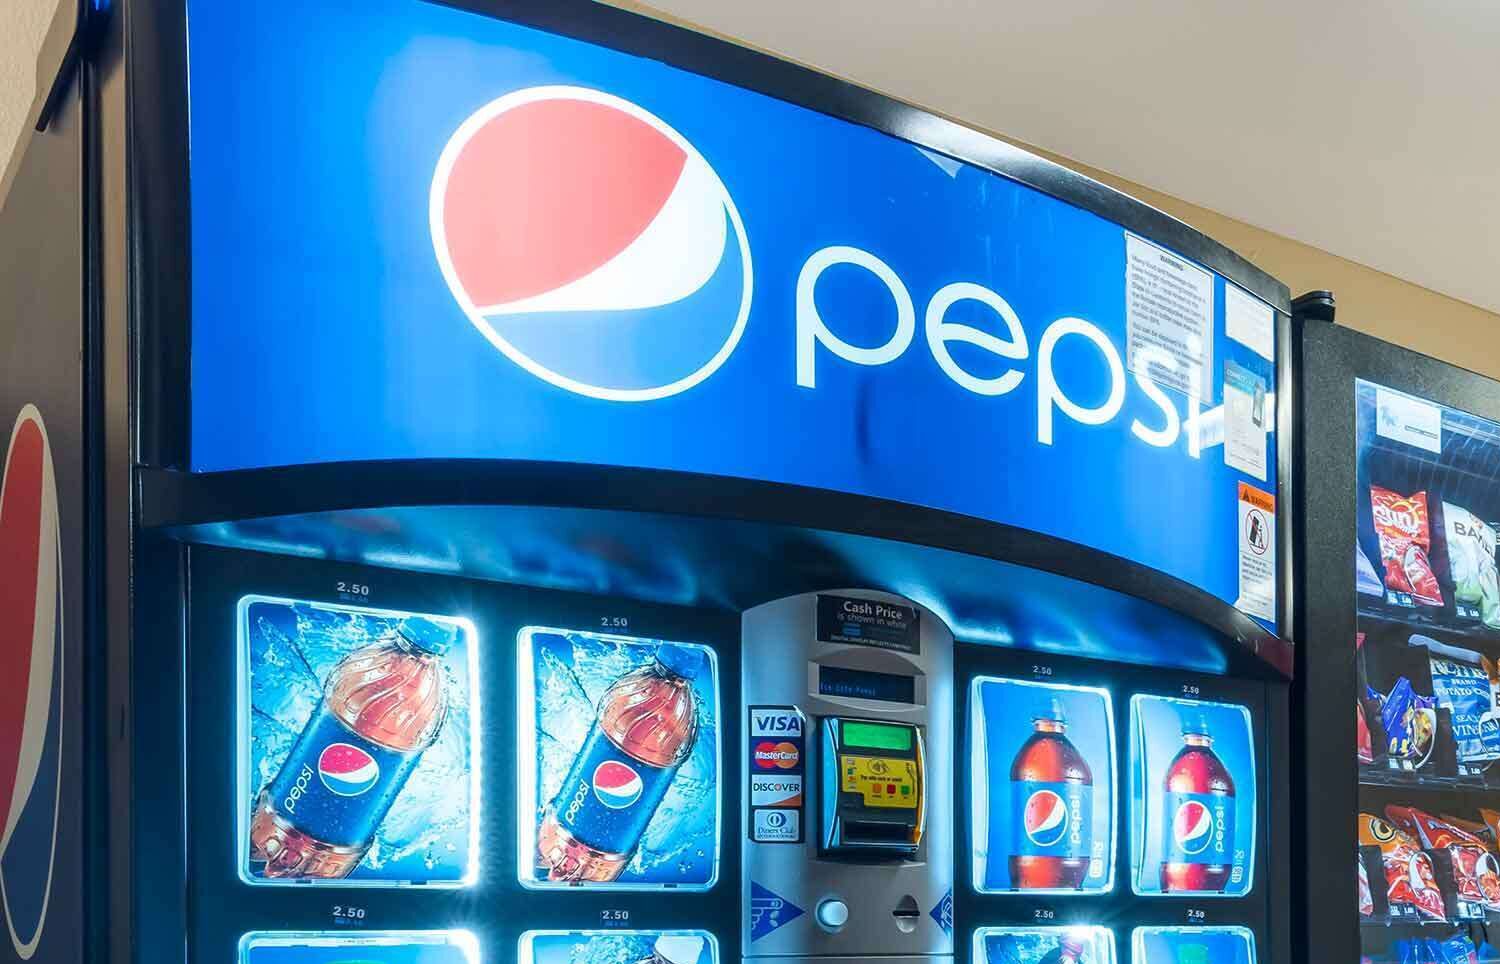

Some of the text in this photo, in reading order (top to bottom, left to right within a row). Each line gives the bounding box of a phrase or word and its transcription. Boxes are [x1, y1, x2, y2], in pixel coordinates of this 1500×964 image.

[796, 246, 1202, 459] pepsi
[337, 582, 369, 596] 2.50
[843, 601, 903, 620] Cash Price
[601, 617, 628, 627] 2.50
[1033, 665, 1052, 675] 2.50
[1183, 685, 1199, 694] 2.50
[757, 716, 801, 731] VISA
[755, 751, 799, 761] MasterCard
[284, 763, 314, 815] pepsi
[753, 783, 801, 792] DISCOVER
[565, 778, 590, 826] pepsi
[1070, 795, 1082, 844] pepsi
[1214, 805, 1225, 852] pepsi
[333, 906, 365, 919] 2.50
[602, 910, 629, 920] 2.50
[1035, 910, 1054, 919] 2.50
[1188, 909, 1205, 918] 2.50
